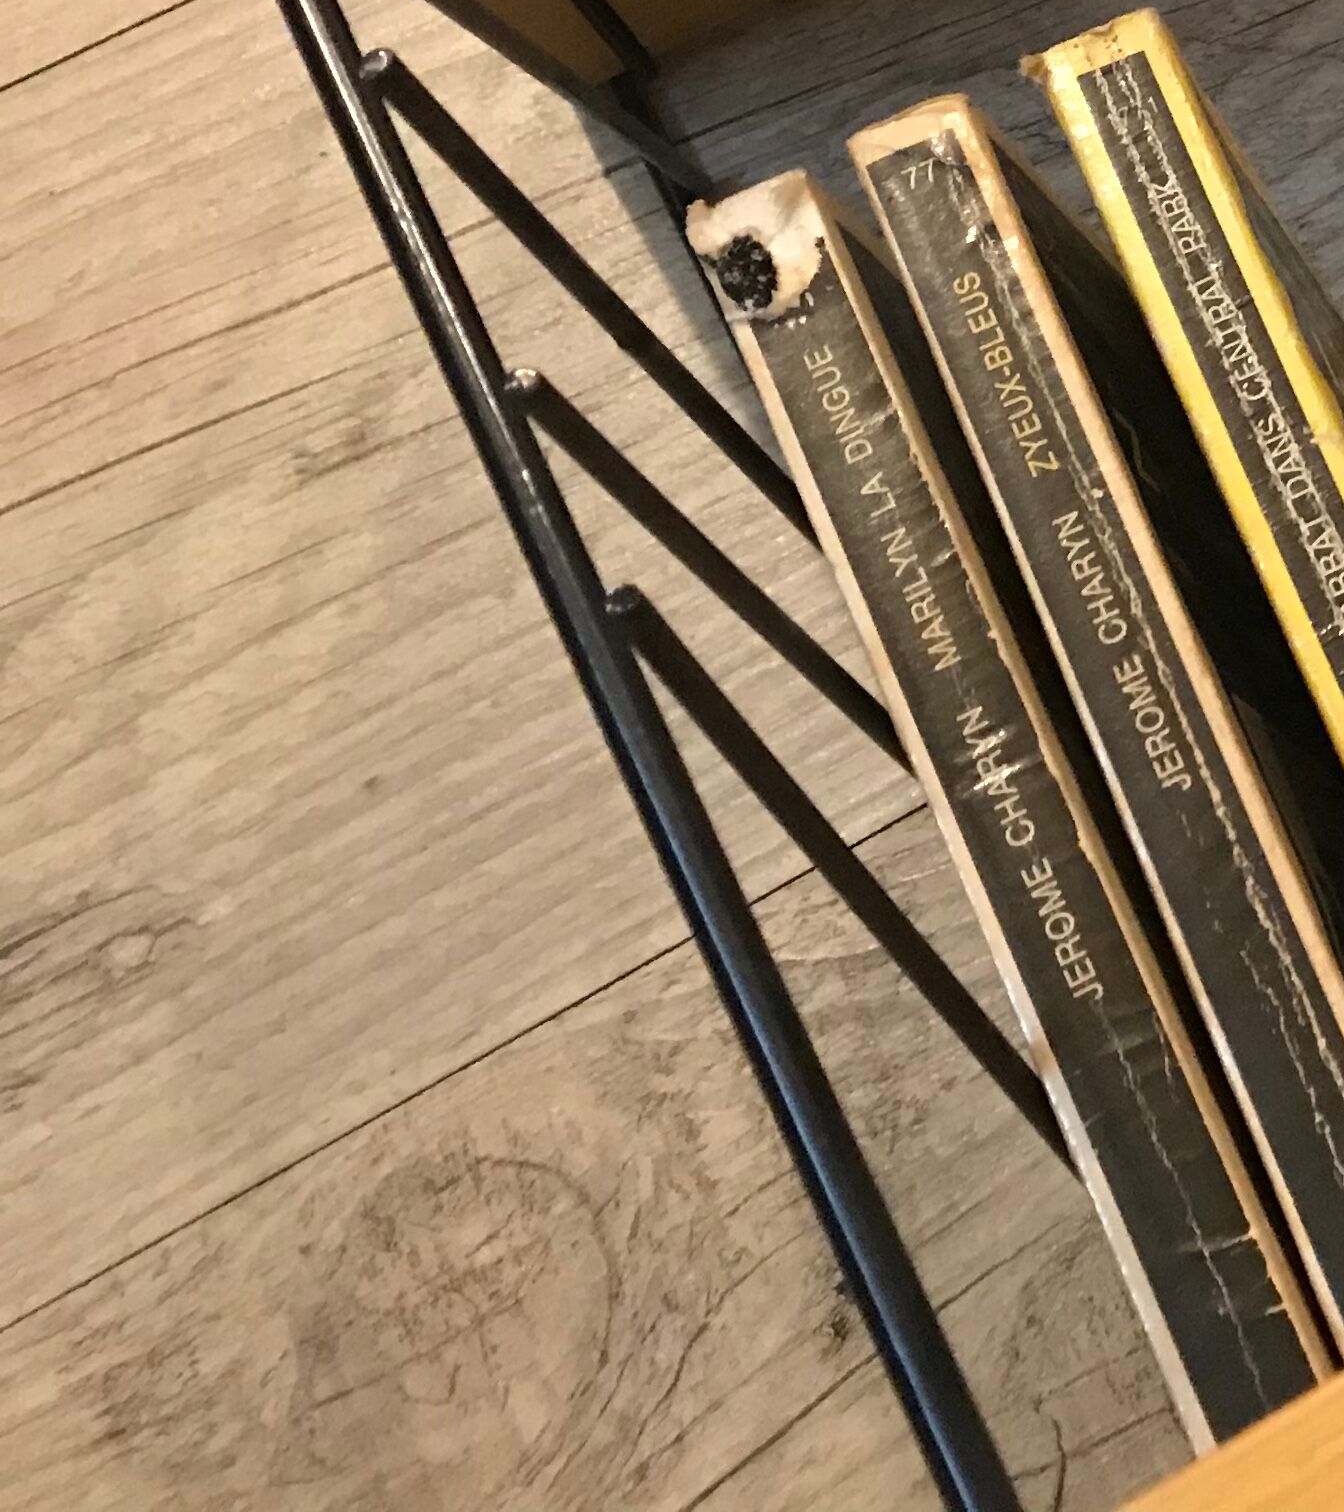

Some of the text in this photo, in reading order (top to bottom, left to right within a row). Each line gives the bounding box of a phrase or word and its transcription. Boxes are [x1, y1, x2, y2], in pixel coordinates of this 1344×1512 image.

[1150, 173, 1207, 256] PARK
[1191, 269, 1270, 403] CENTRAL
[1254, 411, 1314, 501] DANS
[949, 268, 1194, 799] JEROME CHARYN ZYEUX-BLEUS
[802, 343, 1106, 1008] JEROME CHARYN MARILYN LA DINGUE
